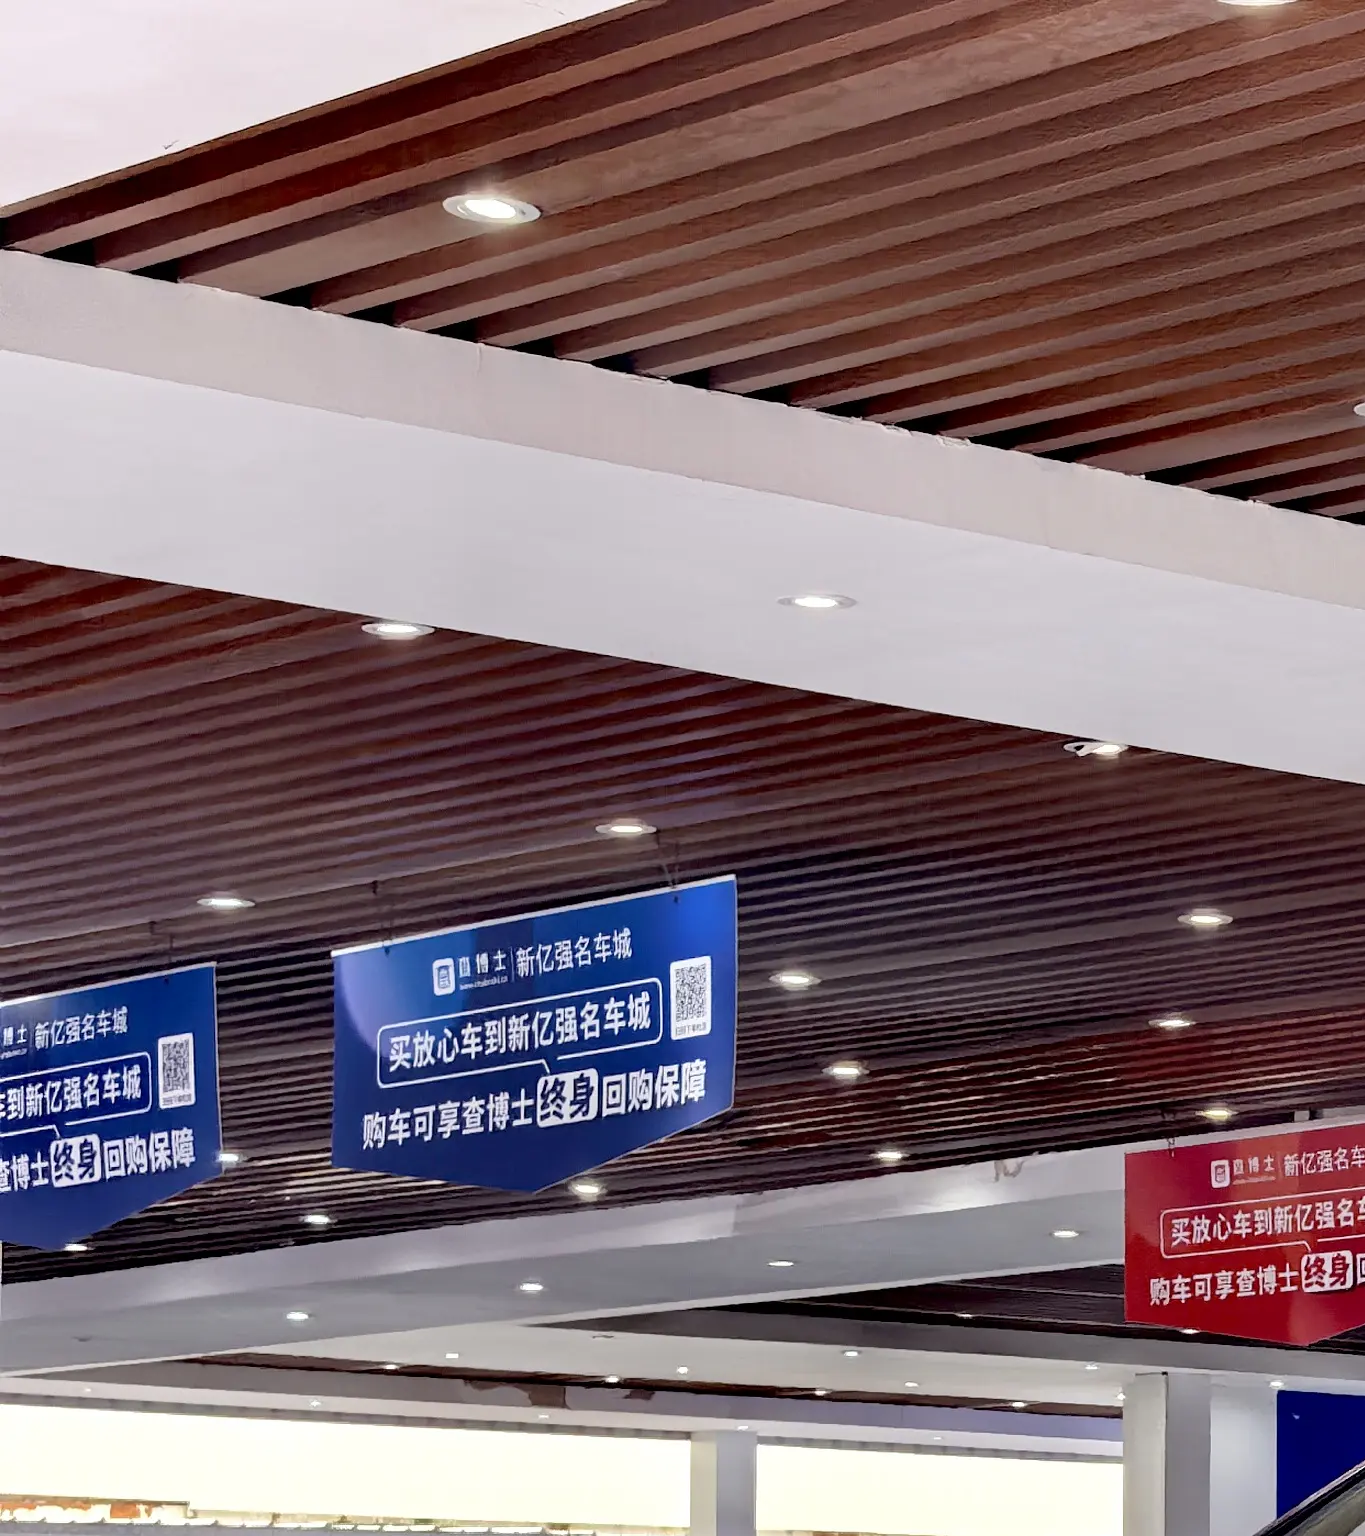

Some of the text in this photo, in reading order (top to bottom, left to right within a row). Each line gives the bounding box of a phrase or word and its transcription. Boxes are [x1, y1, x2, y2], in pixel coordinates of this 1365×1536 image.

[515, 927, 633, 977] 新亿强名车城
[35, 1005, 129, 1051] 新亿强名车城
[388, 990, 652, 1073] 买放心车到新亿强名车城
[362, 1059, 707, 1151] 购车可享查博士终身回购保障
